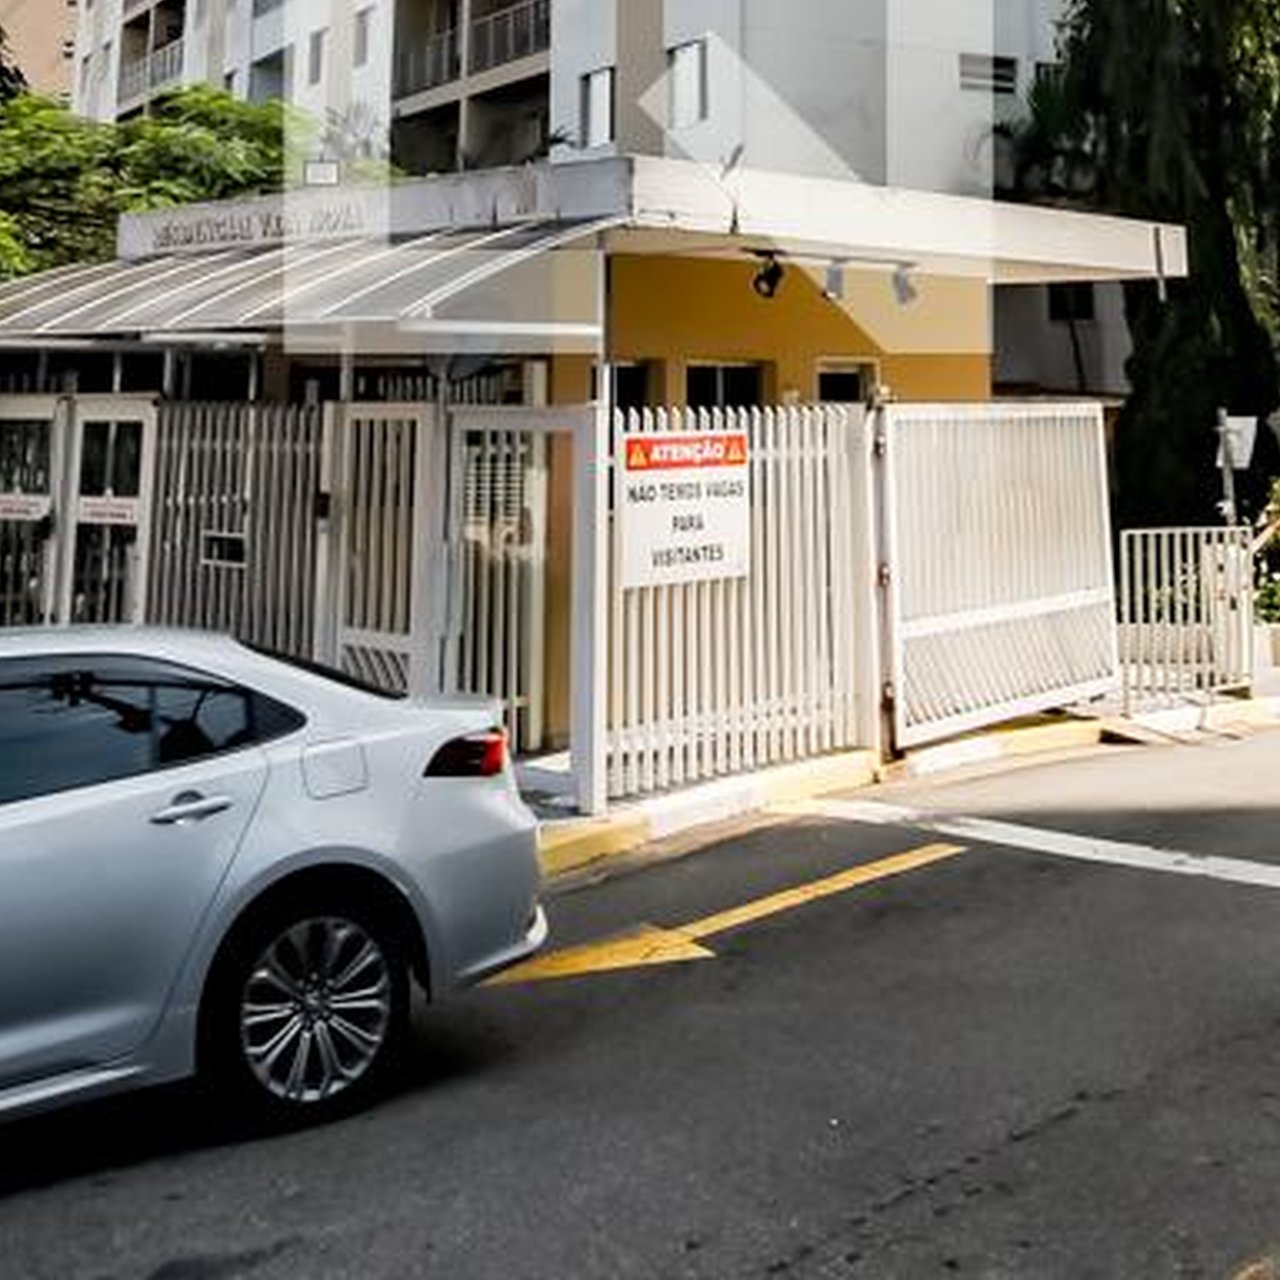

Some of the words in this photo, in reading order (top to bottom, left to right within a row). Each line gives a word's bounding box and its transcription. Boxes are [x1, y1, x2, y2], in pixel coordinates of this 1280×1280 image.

[650, 439, 724, 465] ATENÇÃO
[660, 481, 701, 501] TEMOS
[706, 479, 744, 498] VAGAS
[672, 514, 705, 532] PARA
[652, 544, 724, 567] VISITANTES
